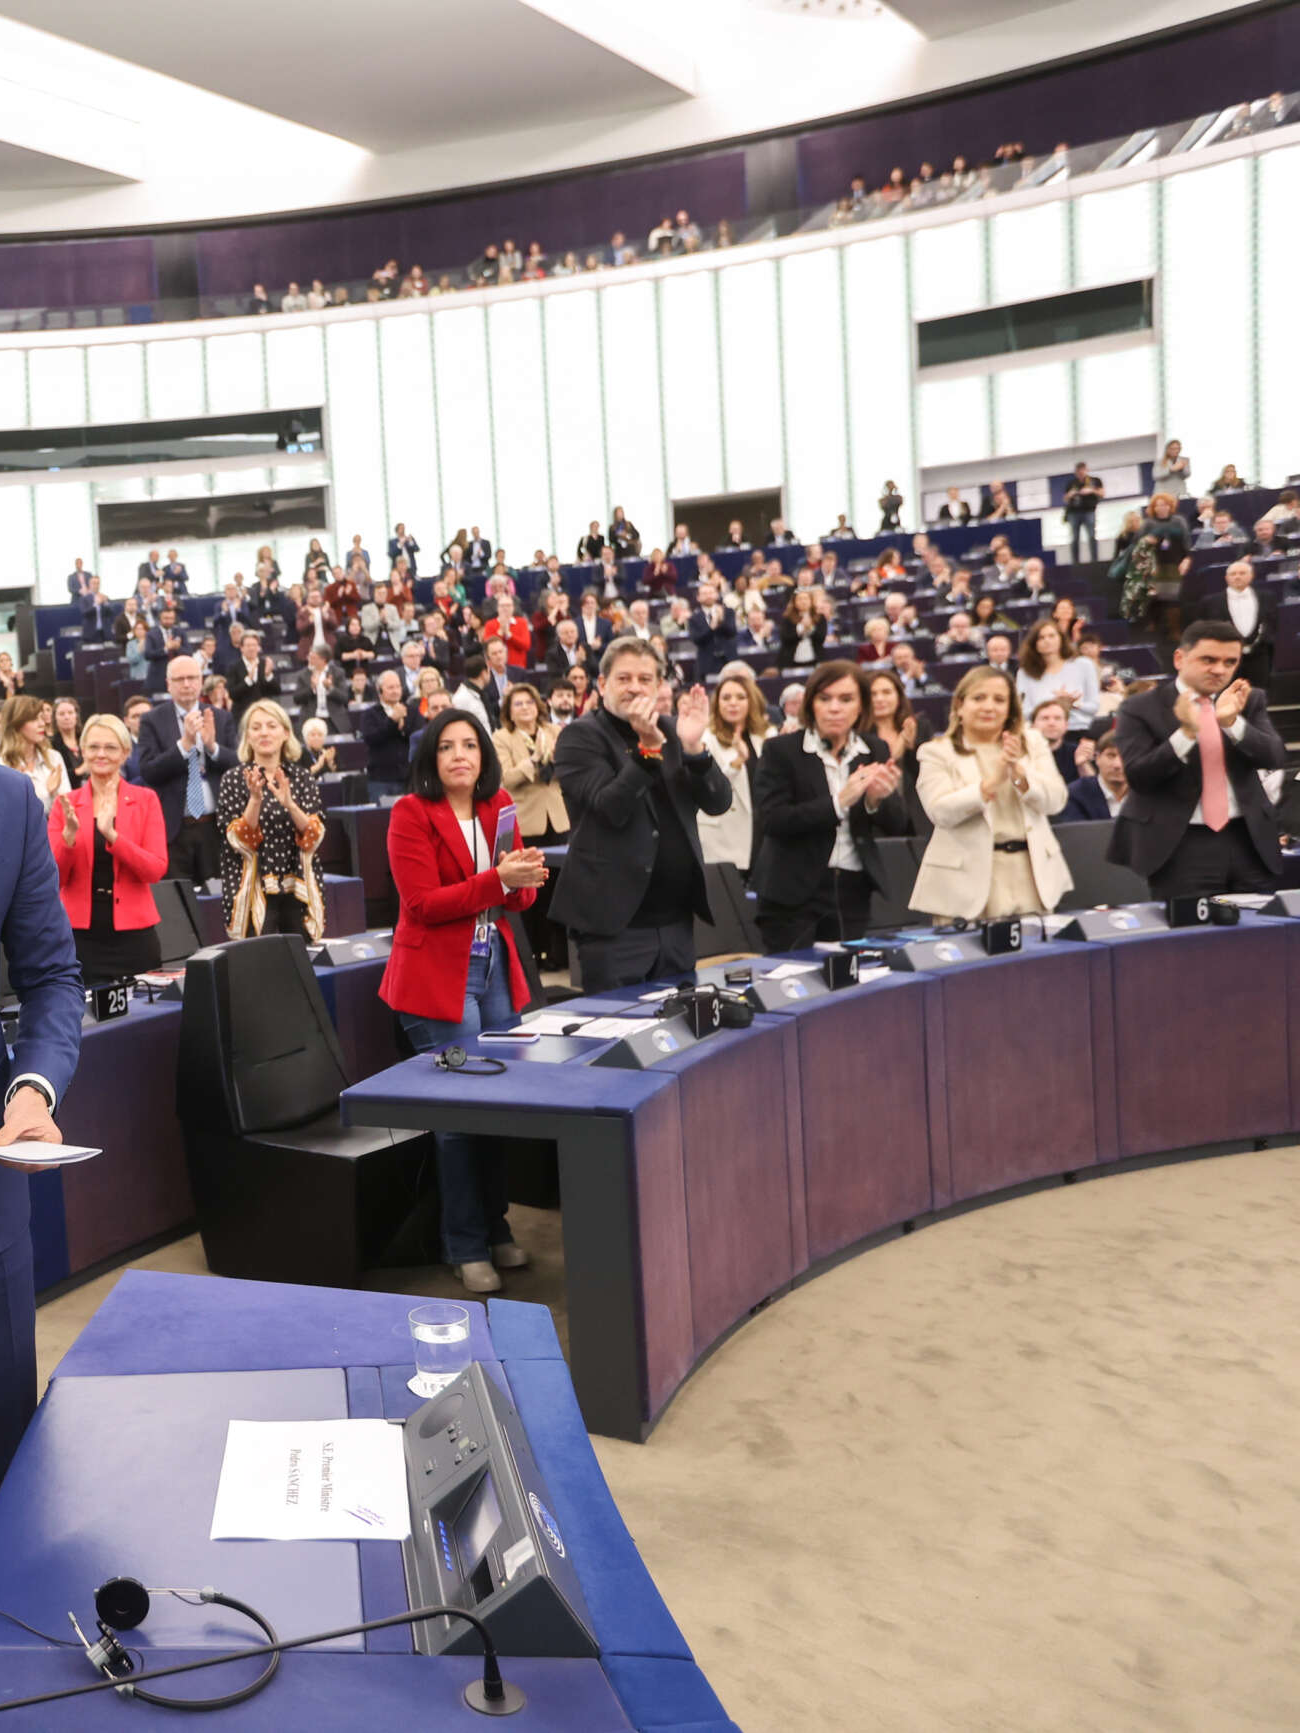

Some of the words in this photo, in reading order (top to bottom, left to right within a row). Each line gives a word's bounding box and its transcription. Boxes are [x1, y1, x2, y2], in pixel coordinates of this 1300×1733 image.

[1196, 897, 1209, 921] 6
[1010, 921, 1021, 949] 5
[848, 957, 858, 981] 4
[108, 988, 126, 1014] 25
[711, 1000, 721, 1027] 3
[289, 1449, 302, 1468] Pedro
[321, 1455, 334, 1481] Premier
[320, 1483, 333, 1512] Ministre
